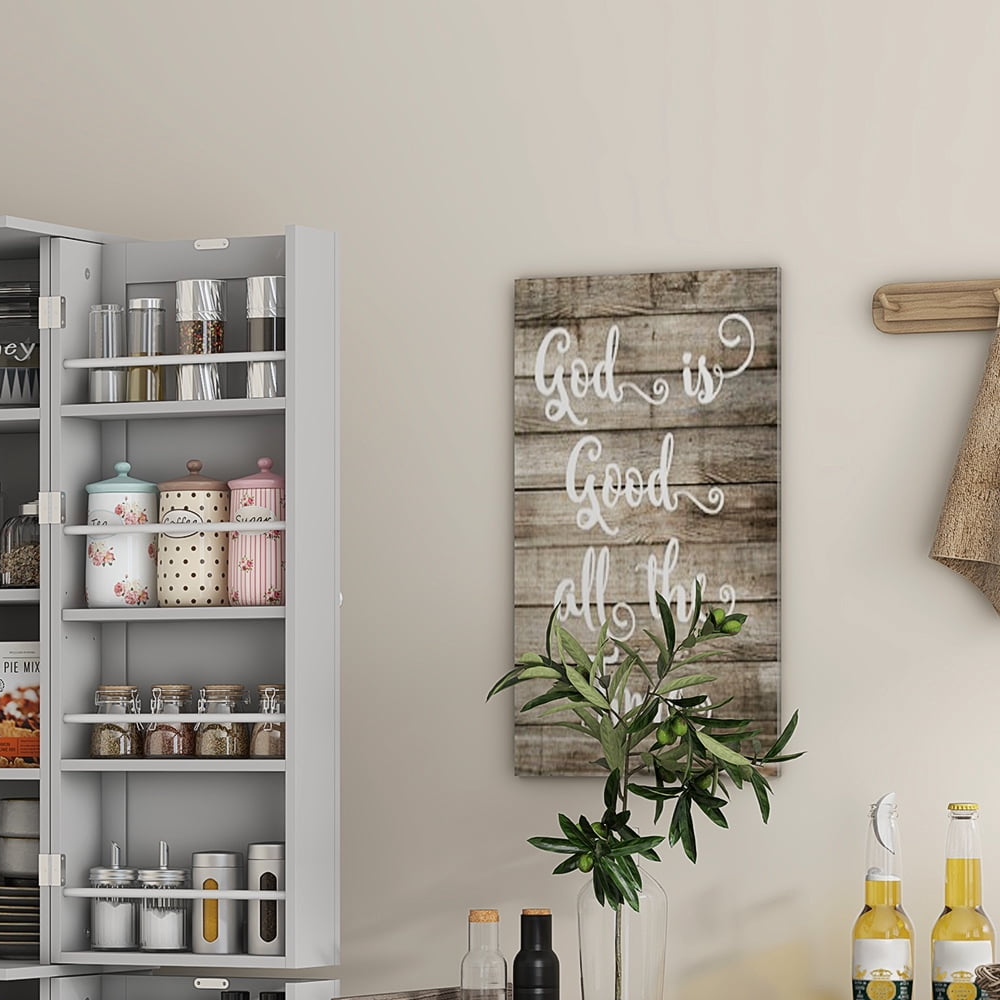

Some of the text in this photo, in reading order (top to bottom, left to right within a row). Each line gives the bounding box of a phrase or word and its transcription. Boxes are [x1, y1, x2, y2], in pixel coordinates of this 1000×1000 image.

[535, 313, 755, 426] God is
[566, 432, 724, 535] Good
[554, 546, 636, 641] all
[4, 661, 40, 673] PIE MIX
